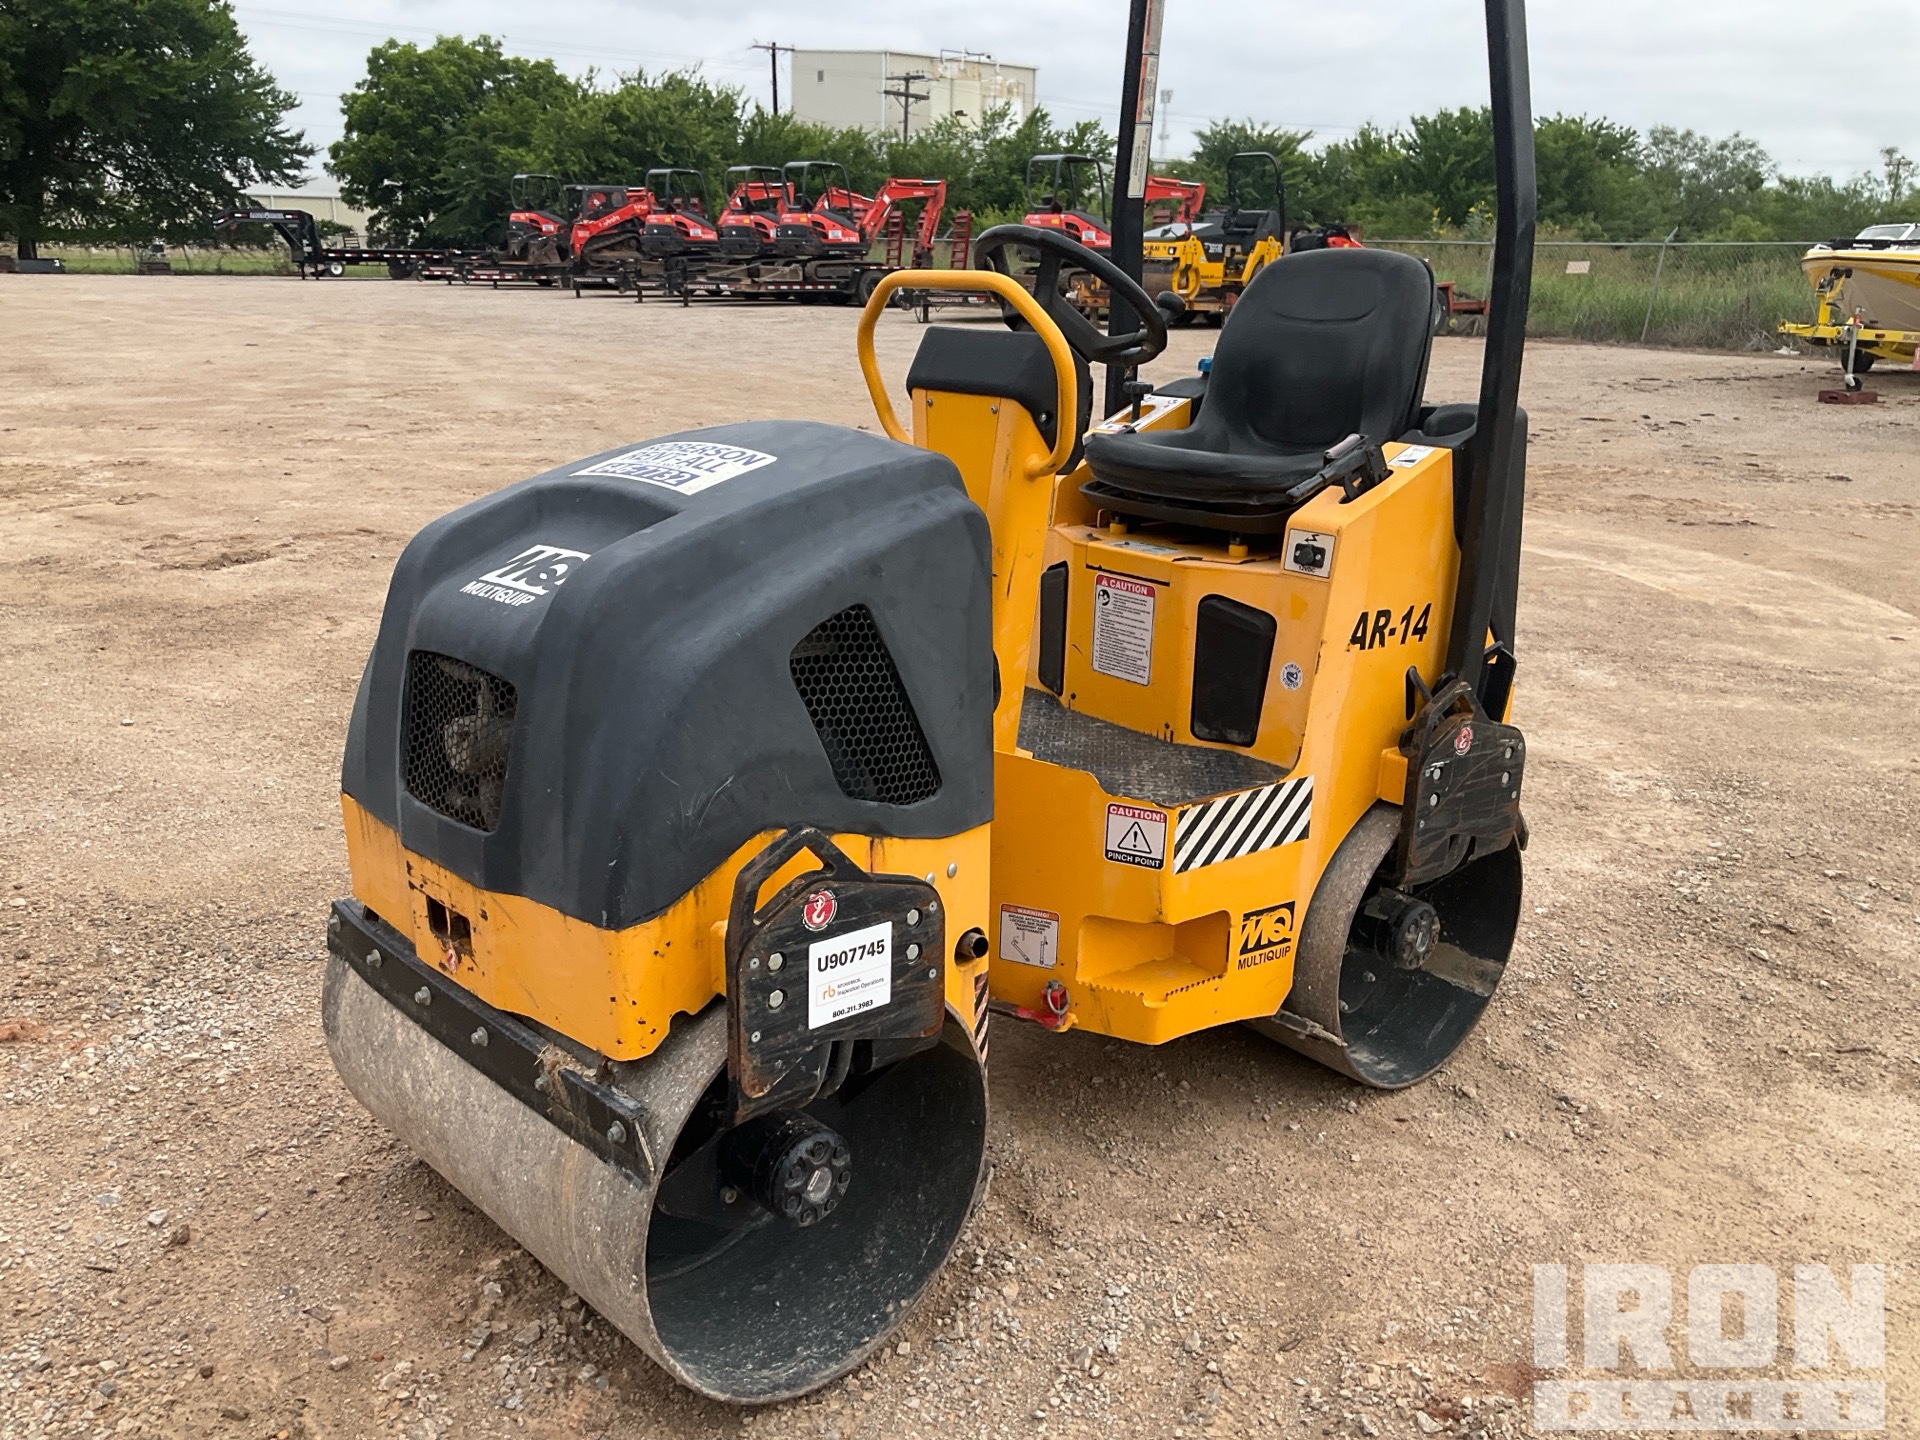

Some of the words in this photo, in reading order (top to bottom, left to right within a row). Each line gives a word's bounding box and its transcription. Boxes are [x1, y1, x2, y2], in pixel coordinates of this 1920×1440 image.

[459, 580, 536, 607] MULTIQUIP
[1109, 580, 1148, 595] CAUTION
[1349, 602, 1432, 651] AR-14
[1109, 805, 1165, 822] CAUTION!
[1107, 851, 1133, 863] PINCH
[1134, 856, 1160, 868] POINT
[817, 939, 885, 973] U907745
[1237, 946, 1291, 970] MULTIQUIP
[822, 984, 836, 1000] rb
[860, 977, 885, 989] Operations
[832, 999, 874, 1018] 800.211.3983
